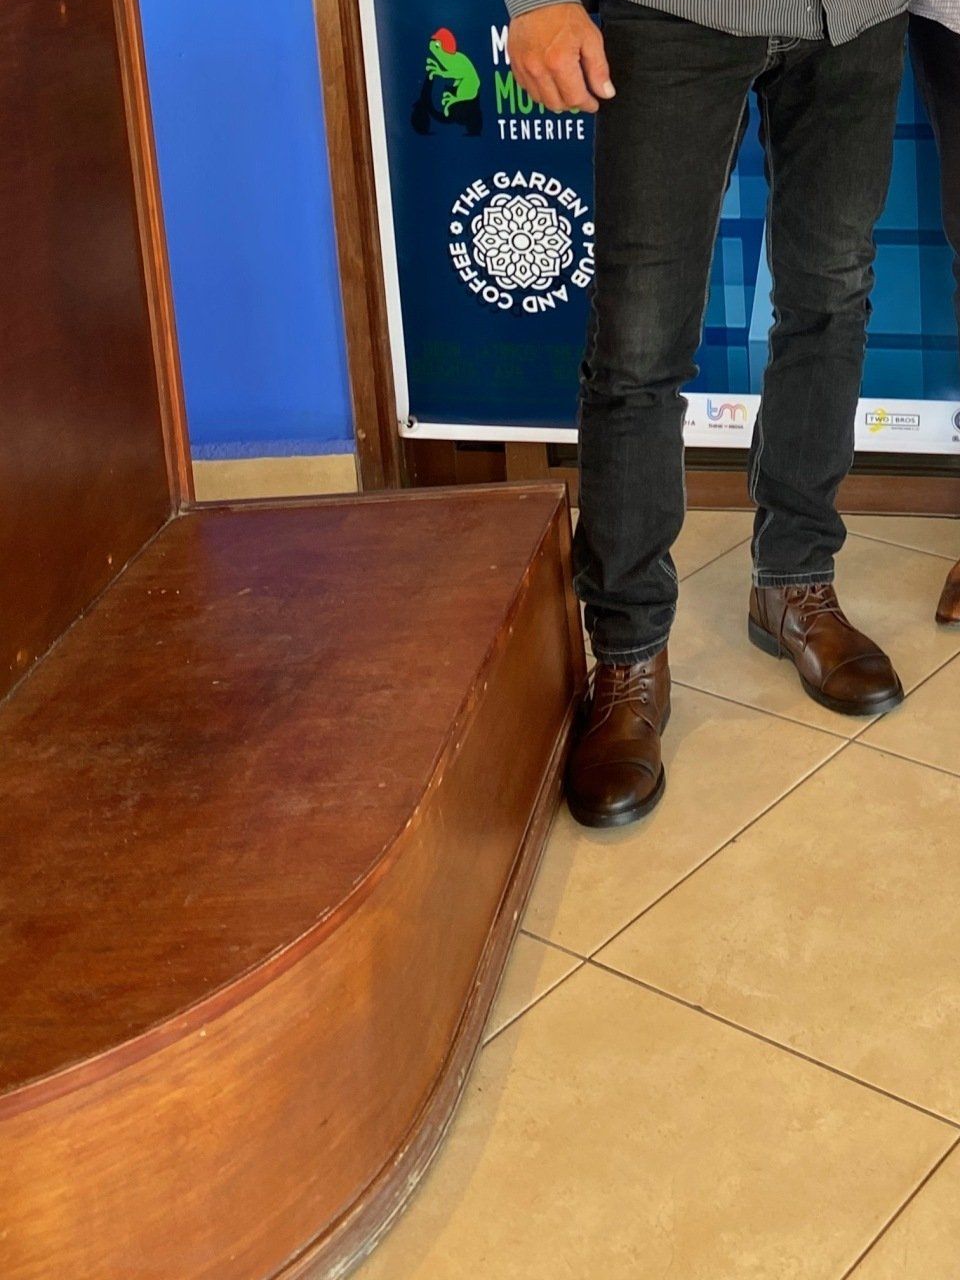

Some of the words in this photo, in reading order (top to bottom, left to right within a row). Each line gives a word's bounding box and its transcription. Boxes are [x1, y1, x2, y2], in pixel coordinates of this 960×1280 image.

[498, 119, 585, 140] TENERIFE
[452, 179, 490, 216] THE
[493, 170, 588, 218] GARDEN
[449, 241, 514, 310] COFFEE
[522, 284, 568, 313] AND
[895, 416, 916, 424] BROS
